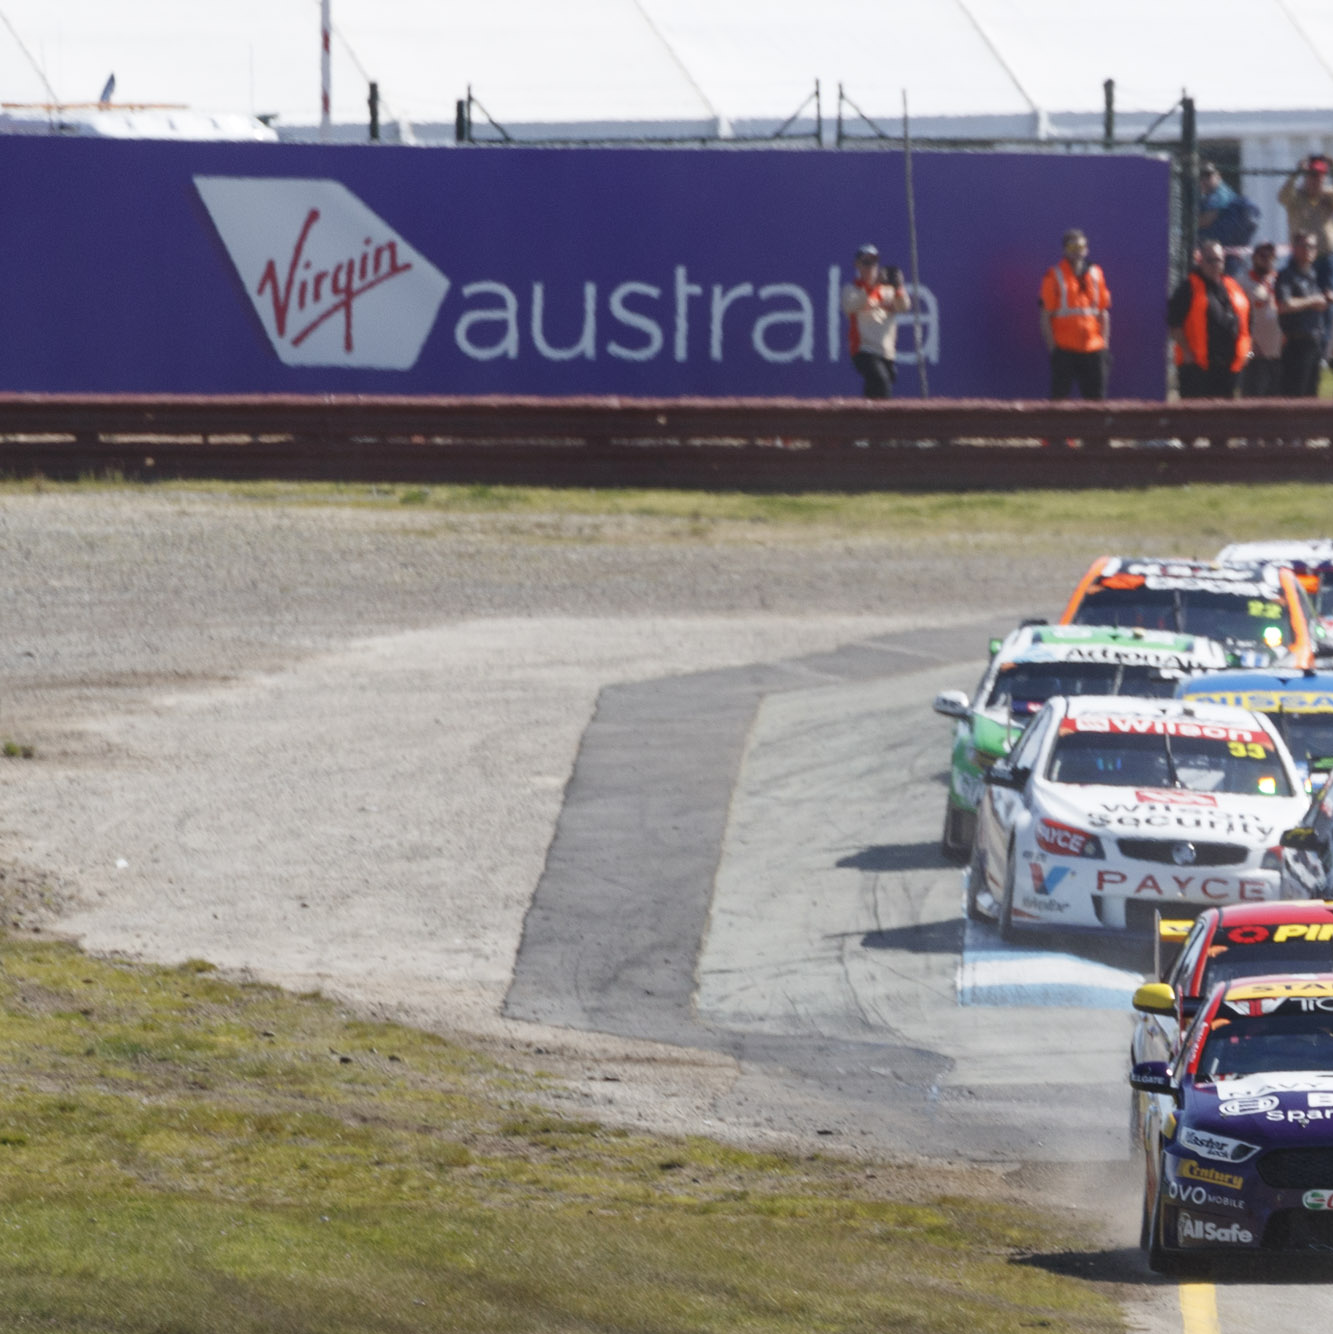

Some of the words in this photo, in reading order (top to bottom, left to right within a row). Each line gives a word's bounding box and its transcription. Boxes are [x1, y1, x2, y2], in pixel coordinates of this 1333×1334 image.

[257, 207, 413, 354] Virgin
[453, 265, 940, 365] australa
[1109, 718, 1253, 743] Wilson
[1228, 741, 1267, 760] 33
[1100, 803, 1261, 823] Wilson
[1087, 811, 1274, 843] Security
[1096, 869, 1266, 902] PAYCE
[1185, 1160, 1244, 1188] Century
[1168, 1181, 1206, 1205] OVO
[1182, 1218, 1253, 1244] AllSafe
